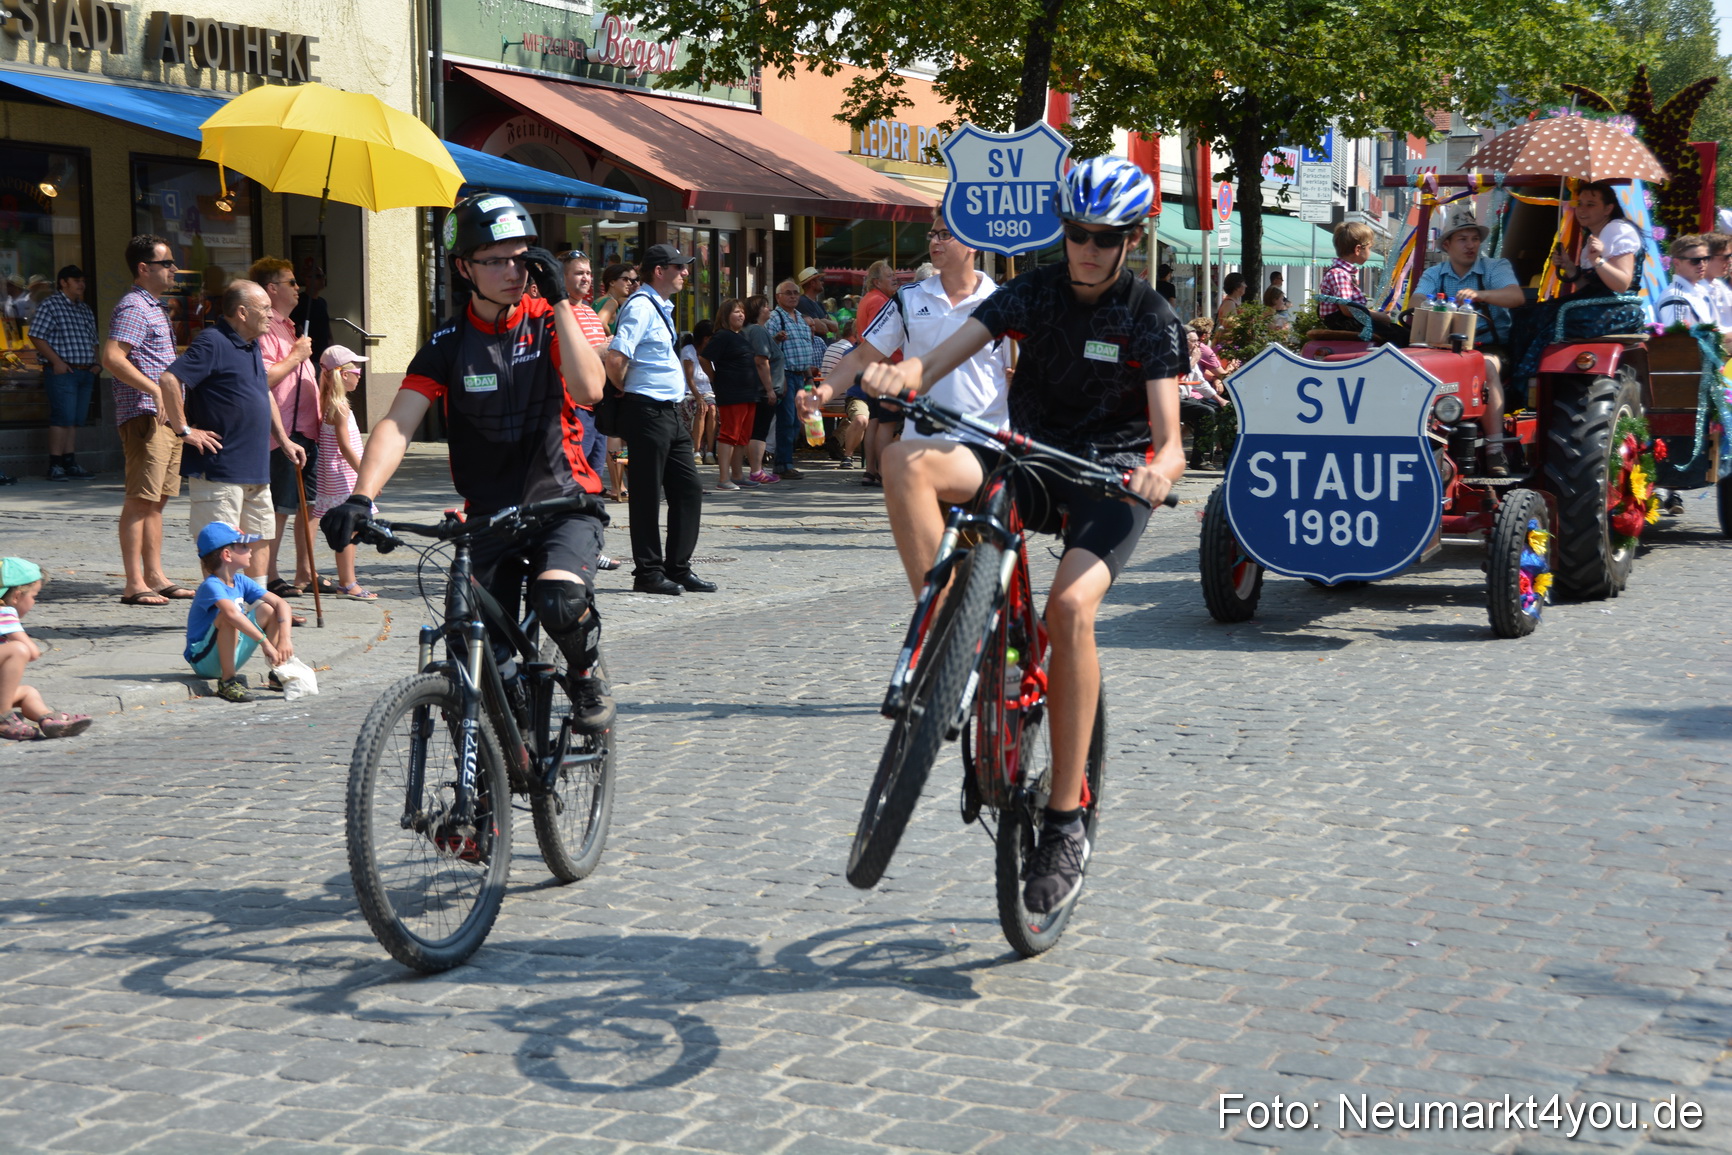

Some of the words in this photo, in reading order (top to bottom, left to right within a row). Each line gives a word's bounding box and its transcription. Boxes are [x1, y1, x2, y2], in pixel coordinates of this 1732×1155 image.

[17, 0, 131, 54] STADT
[153, 11, 321, 83] APOTHEKE
[523, 32, 585, 61] METZGEREI
[597, 13, 680, 78] Bögerl
[861, 119, 911, 160] LEDER
[917, 125, 947, 165] RO
[988, 148, 1024, 178] SV
[966, 184, 1051, 215] STAUF
[985, 219, 1031, 238] 1980
[1096, 344, 1115, 356] DAV
[475, 376, 494, 386] DAV
[1296, 376, 1365, 424] SV
[1249, 451, 1418, 501] STAUF
[1283, 509, 1379, 547] 1980
[462, 733, 479, 792] FOX
